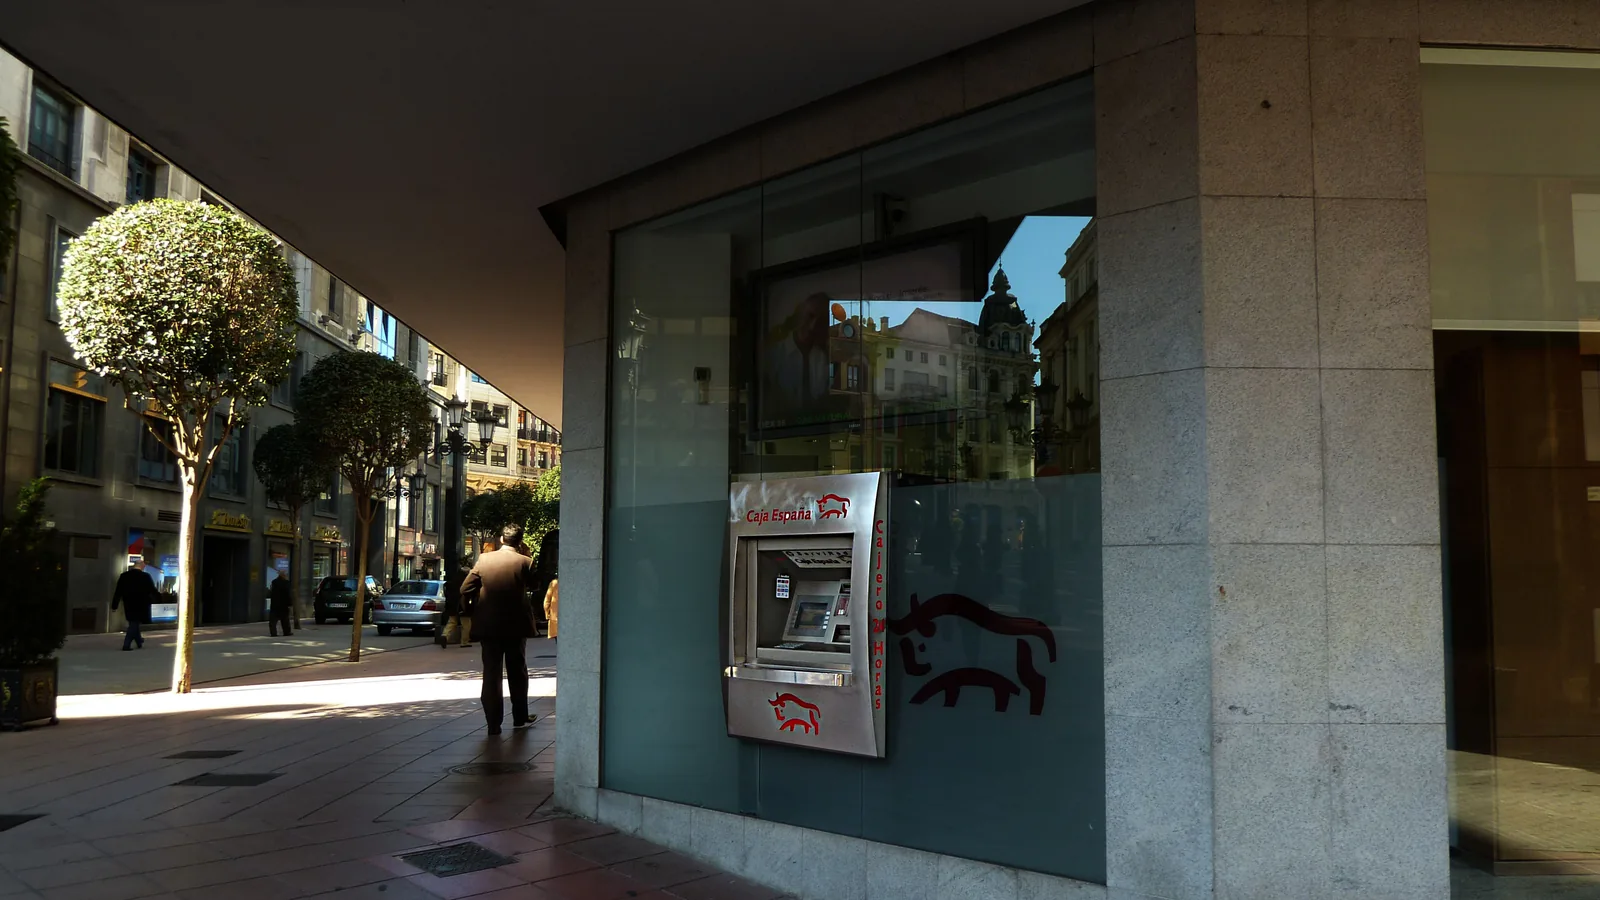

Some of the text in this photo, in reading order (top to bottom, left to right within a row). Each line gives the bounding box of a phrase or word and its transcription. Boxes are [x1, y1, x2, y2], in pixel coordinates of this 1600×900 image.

[746, 507, 812, 526] Caja España
[875, 519, 884, 610] Cajero
[872, 641, 884, 710] Horas
